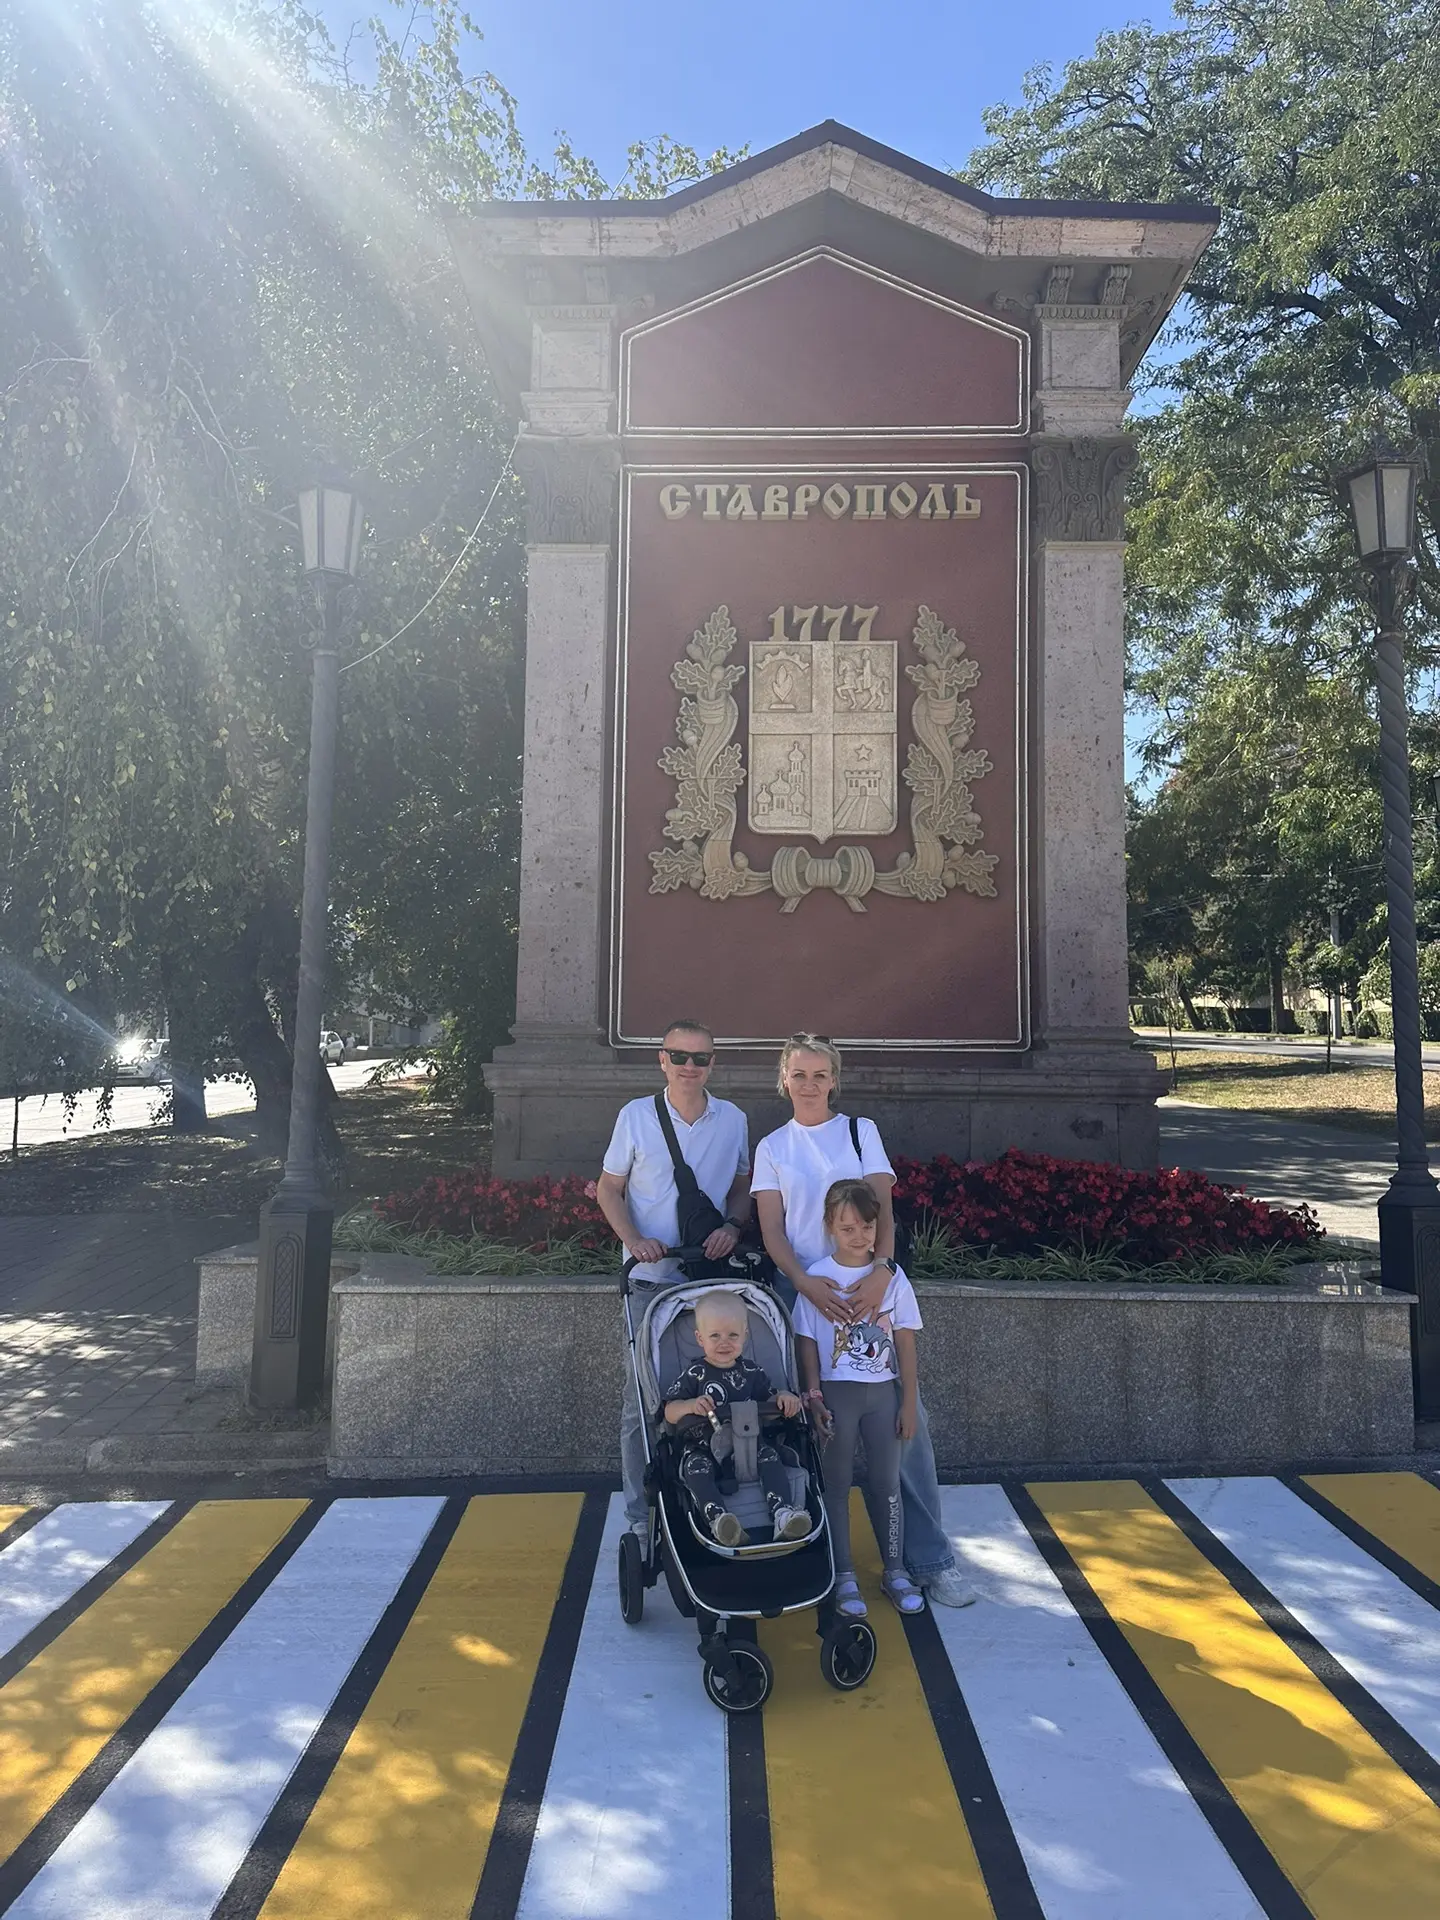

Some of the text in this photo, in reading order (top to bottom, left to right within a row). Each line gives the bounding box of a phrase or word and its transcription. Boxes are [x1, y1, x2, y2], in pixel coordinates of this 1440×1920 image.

[659, 482, 981, 520] СТАВРОПОЛЬ
[768, 605, 879, 641] 1777
[888, 1502, 900, 1558] DAYDREAMER
